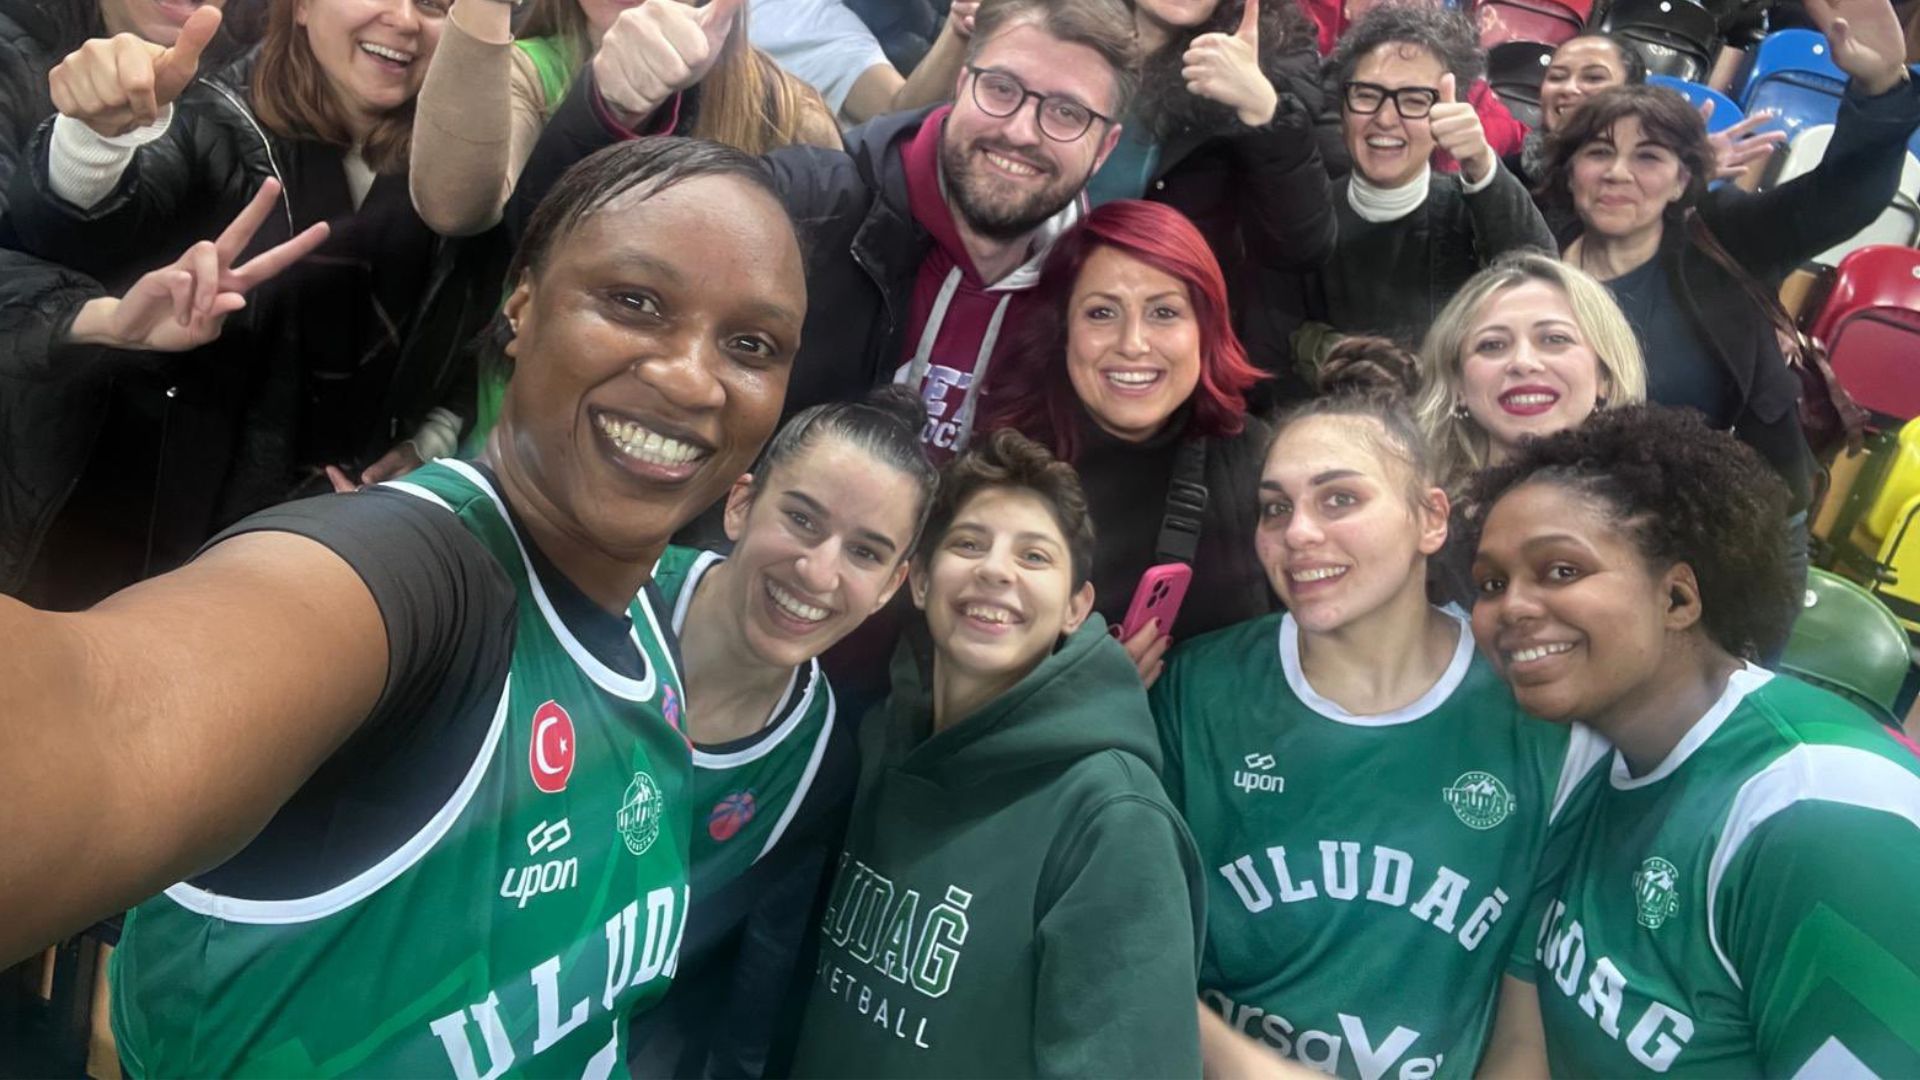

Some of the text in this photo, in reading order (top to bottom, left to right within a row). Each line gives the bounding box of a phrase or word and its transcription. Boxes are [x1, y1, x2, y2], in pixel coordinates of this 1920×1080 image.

[1233, 770, 1285, 793] upon
[500, 856, 578, 909] upon
[822, 851, 974, 998] UDAĞ
[1219, 840, 1509, 952] ULUDAĞ
[816, 961, 929, 1049] KETBALL
[1200, 988, 1444, 1080] arsaVe
